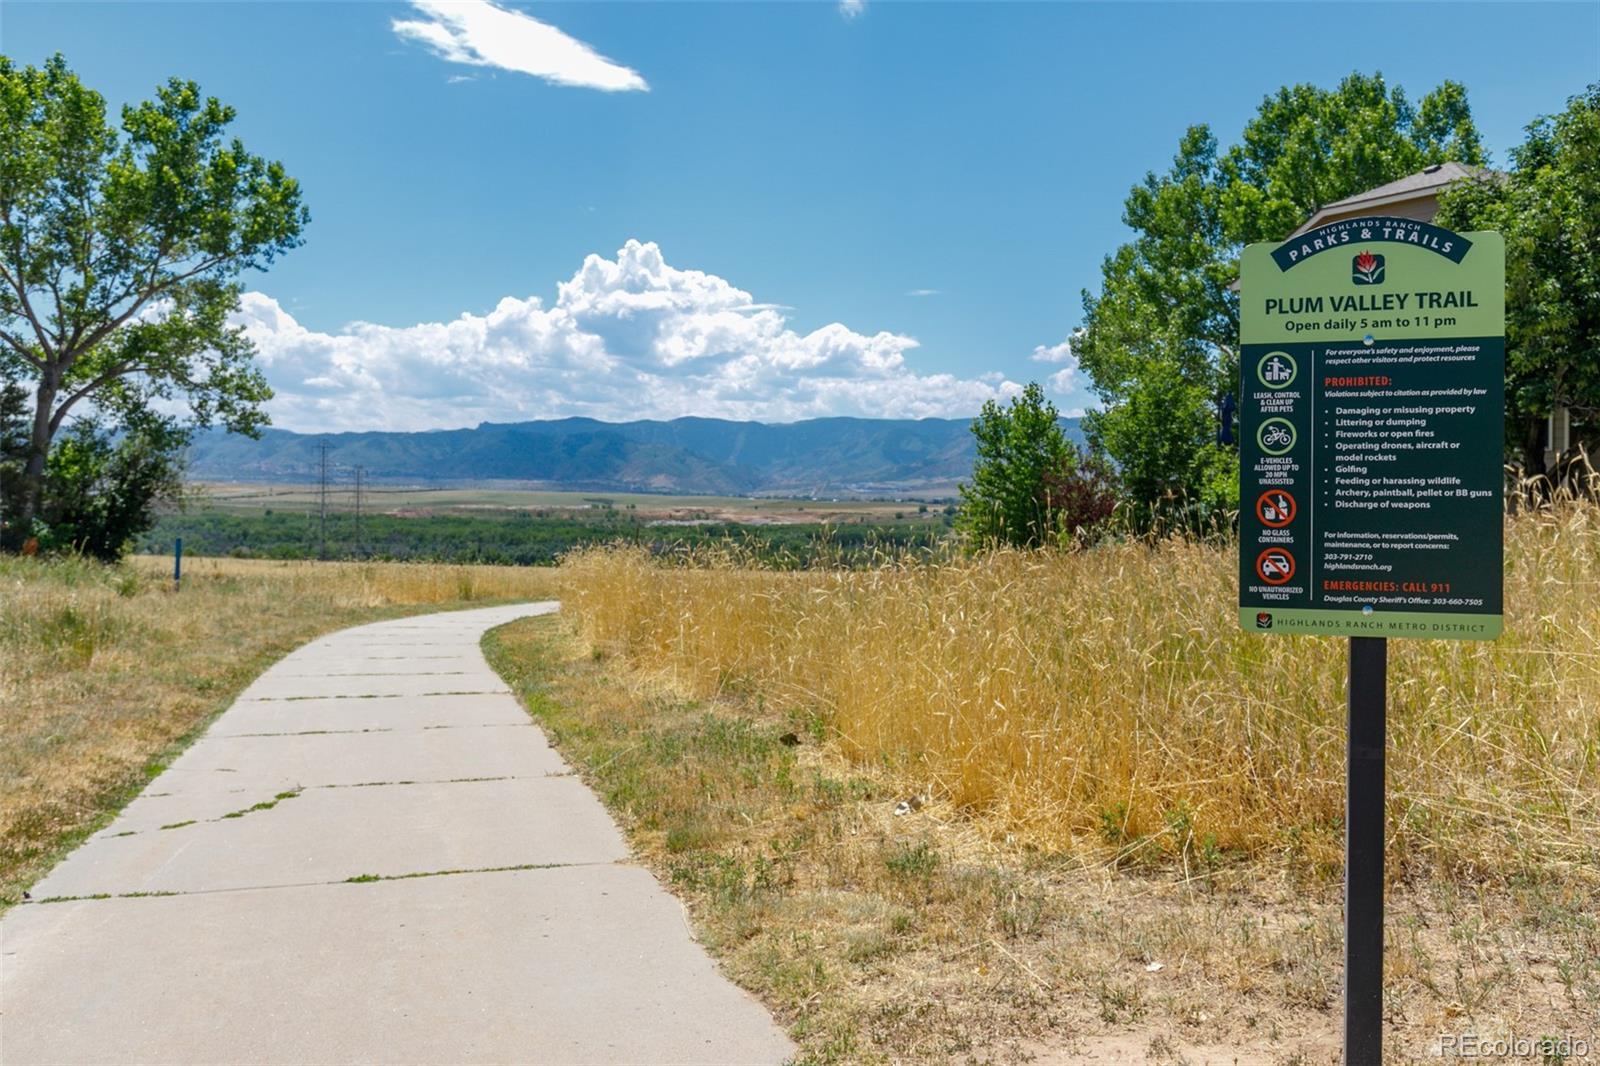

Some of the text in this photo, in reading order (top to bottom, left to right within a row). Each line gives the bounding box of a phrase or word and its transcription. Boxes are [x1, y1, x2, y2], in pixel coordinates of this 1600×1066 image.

[1320, 220, 1421, 236] HIGHLANDS RANCH
[1289, 228, 1454, 262] PARKS & TRAILS
[1266, 291, 1478, 315] PLUM VALLEY TRAIL
[1285, 317, 1456, 333] Open daily 5 am to 11 pm
[1413, 355, 1440, 363] protect
[1324, 377, 1392, 386] PROHIBITED:
[1335, 407, 1380, 416] Damaging
[1435, 406, 1476, 414] property
[1335, 419, 1373, 427] Littering
[1386, 418, 1426, 426] dumping
[1335, 466, 1367, 474] Golfing
[1335, 477, 1370, 486] Feeding
[1383, 477, 1425, 485] harassing
[1335, 501, 1378, 509] Discharge
[1337, 532, 1380, 540] information,
[1324, 563, 1392, 572] highlandsranch.org
[1324, 581, 1450, 593] EMERGENCIES: CALL 911
[1324, 595, 1353, 603] Douglas
[1354, 595, 1378, 605] County
[1378, 595, 1407, 605] Sheriff's
[1408, 596, 1430, 605] Office:
[1277, 619, 1485, 633] HIGHLANDS RANCH METRO DISTRICT
